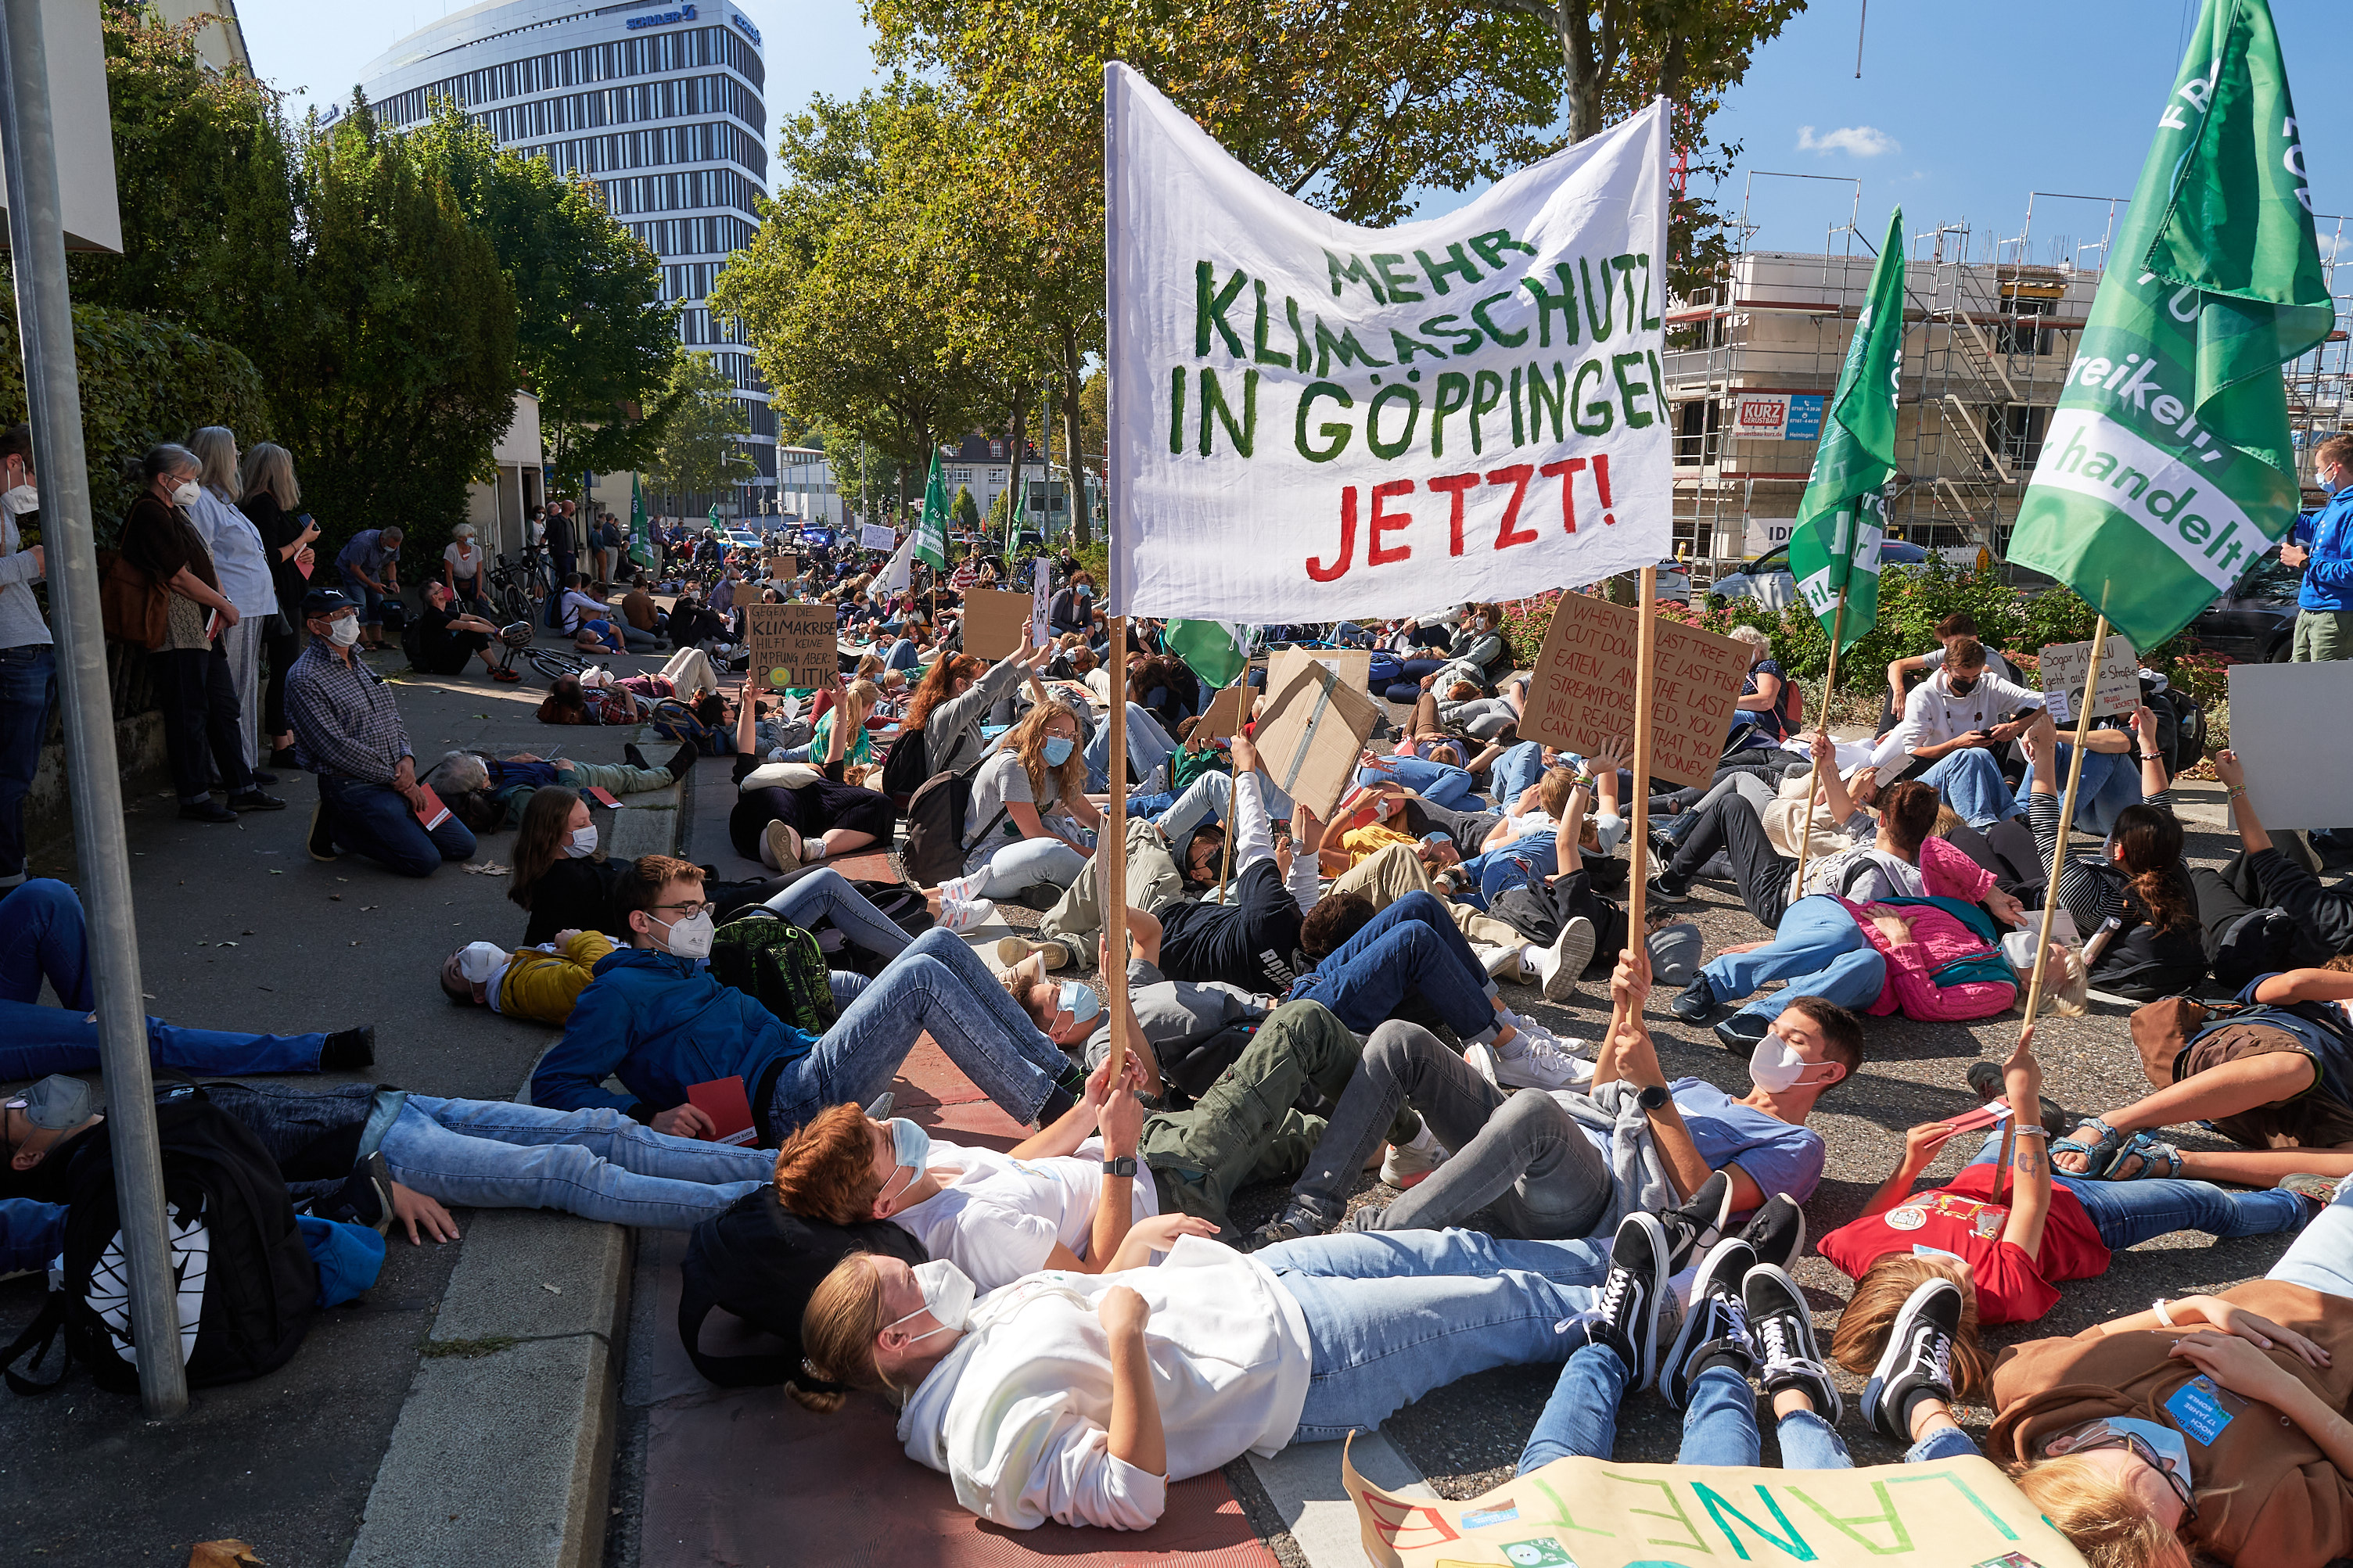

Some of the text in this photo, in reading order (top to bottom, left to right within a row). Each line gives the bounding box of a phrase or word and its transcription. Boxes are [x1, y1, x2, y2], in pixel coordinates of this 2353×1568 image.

[627, 12, 681, 30] SCHULER
[1322, 228, 1539, 306] MEHR
[1169, 365, 1259, 459] IN
[1744, 404, 1781, 418] KURZ
[1306, 454, 1615, 583] JETZT!
[752, 606, 815, 620] GEGEN DIE
[753, 621, 836, 636] KLIMAKRISE
[1574, 603, 1623, 631] WHEN
[1656, 630, 1689, 650] LAST
[1692, 640, 1728, 664] TREE
[1732, 654, 1746, 671] IS
[756, 637, 824, 650] HILFT KEINE
[756, 651, 832, 666] IMPFUNG ABER:
[1564, 624, 1601, 648] CUT
[1601, 636, 1637, 660] DOW
[1675, 659, 1713, 684] LAST
[1714, 670, 1743, 693] FISH
[2043, 651, 2073, 671] Sogar
[1554, 649, 1730, 718] EATEN, AN THE LAST
[2046, 672, 2065, 692] geht
[2071, 669, 2085, 684] auf
[2108, 665, 2138, 680] Straße
[1547, 694, 1574, 722] WILL
[1581, 706, 1635, 737] REALIZ
[1651, 727, 1688, 749] THAT
[1693, 741, 1719, 761] YOU
[1689, 715, 1718, 737] YOU
[1541, 717, 1573, 739] CAN
[1654, 748, 1708, 780] MONEY.
[2183, 1402, 2210, 1420] JAHRE
[2187, 1394, 2214, 1412] KOHLE
[2171, 1412, 2209, 1442] OHNE DIC
[2190, 1418, 2215, 1436] NOCH
[1362, 1470, 2034, 1561] LANET B
